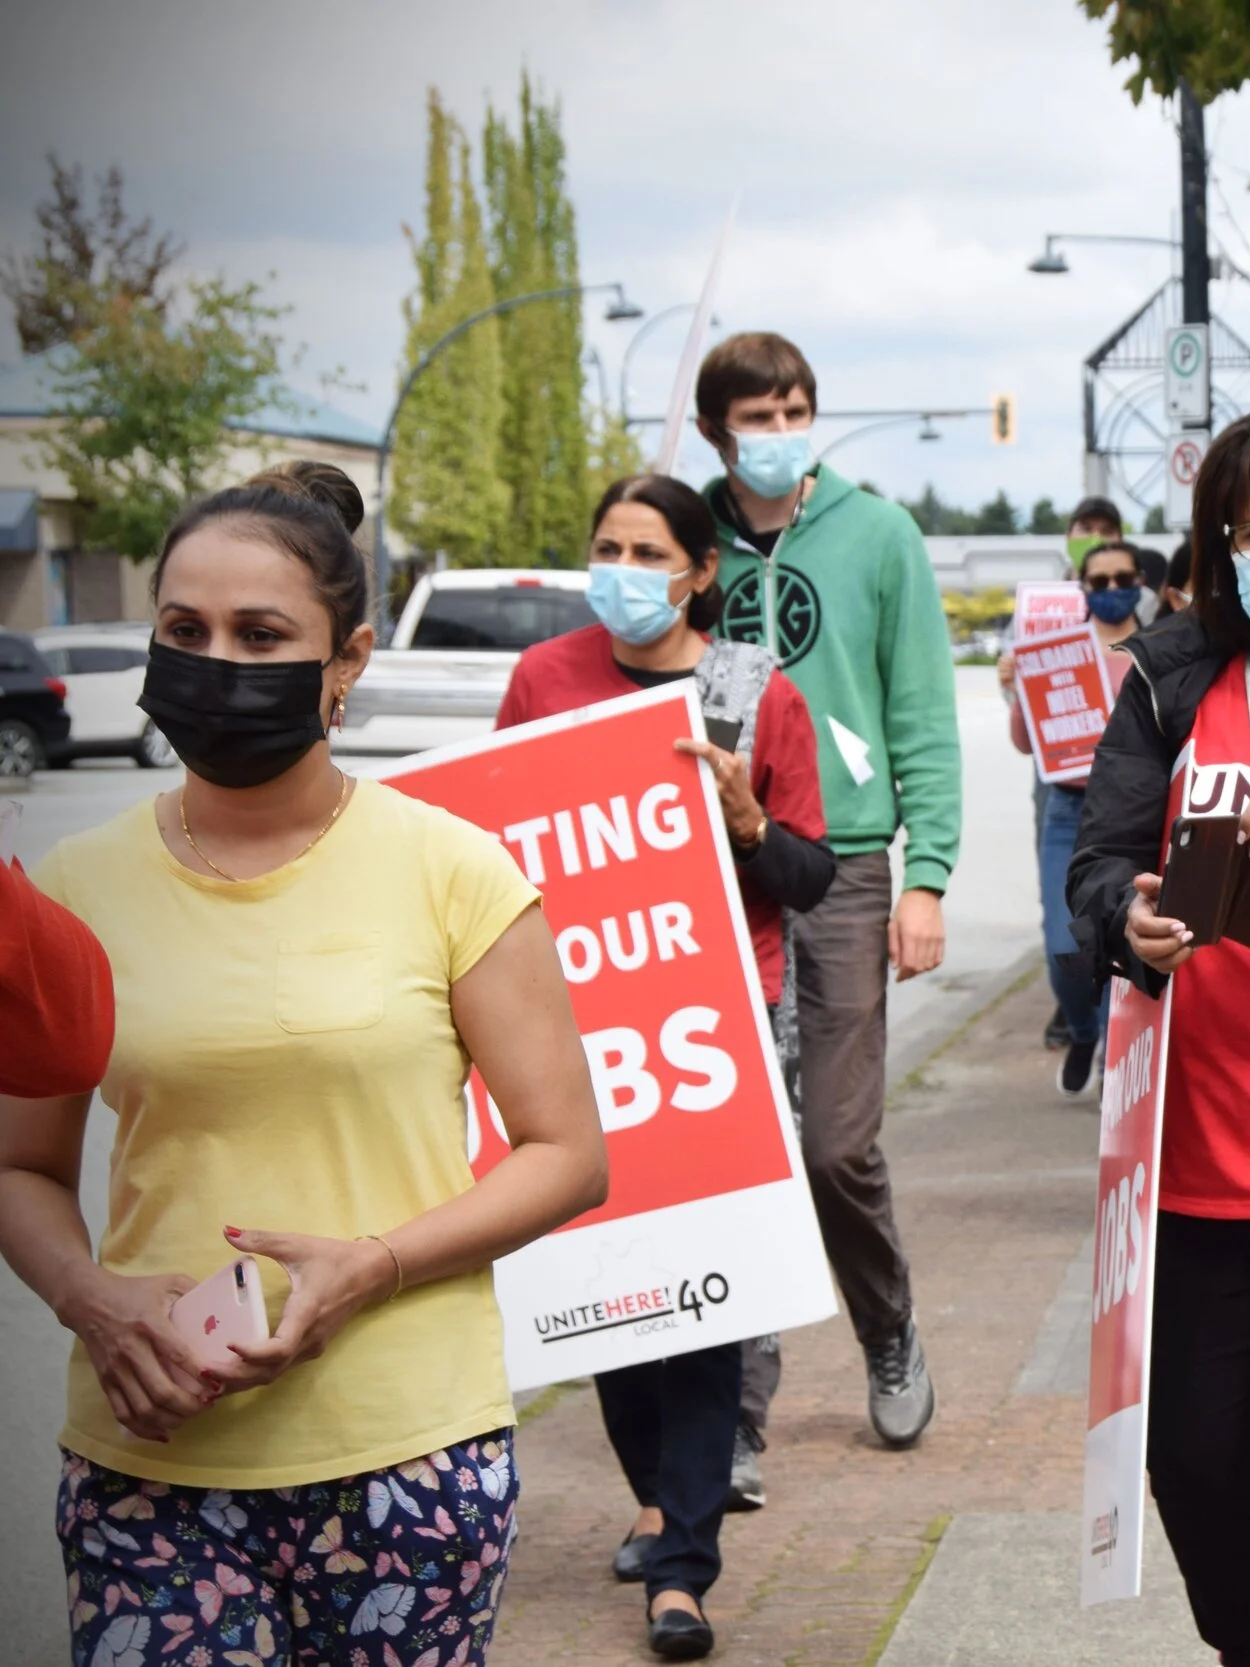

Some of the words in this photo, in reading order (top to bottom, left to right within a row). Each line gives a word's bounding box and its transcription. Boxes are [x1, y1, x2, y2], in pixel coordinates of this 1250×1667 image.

[1016, 642, 1096, 679] SOLIDARITY
[1040, 708, 1106, 745] WORKERS
[488, 783, 693, 886] TING
[556, 900, 702, 984] OUR
[1124, 1025, 1154, 1113] OUR
[1092, 1161, 1147, 1326] JOBS
[633, 1319, 679, 1337] LOCAL
[678, 1271, 730, 1322] 40
